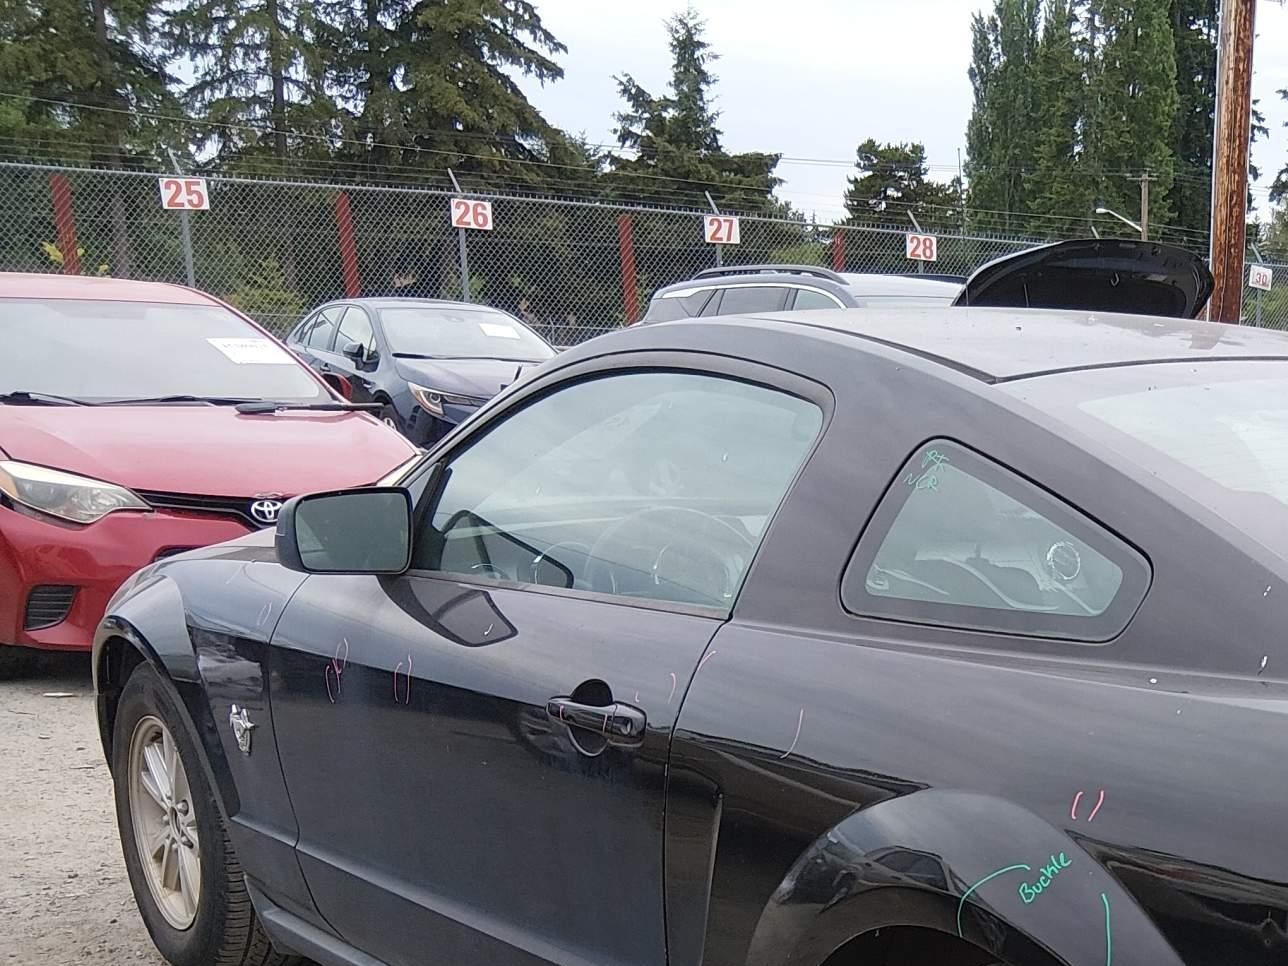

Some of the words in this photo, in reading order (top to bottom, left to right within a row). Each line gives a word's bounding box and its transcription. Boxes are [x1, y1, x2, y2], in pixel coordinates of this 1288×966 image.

[164, 180, 204, 208] 25
[454, 200, 488, 228] 26
[709, 218, 734, 242] 27
[909, 236, 934, 259] 28
[1255, 272, 1268, 286] 30
[1019, 852, 1072, 903] Buckle
